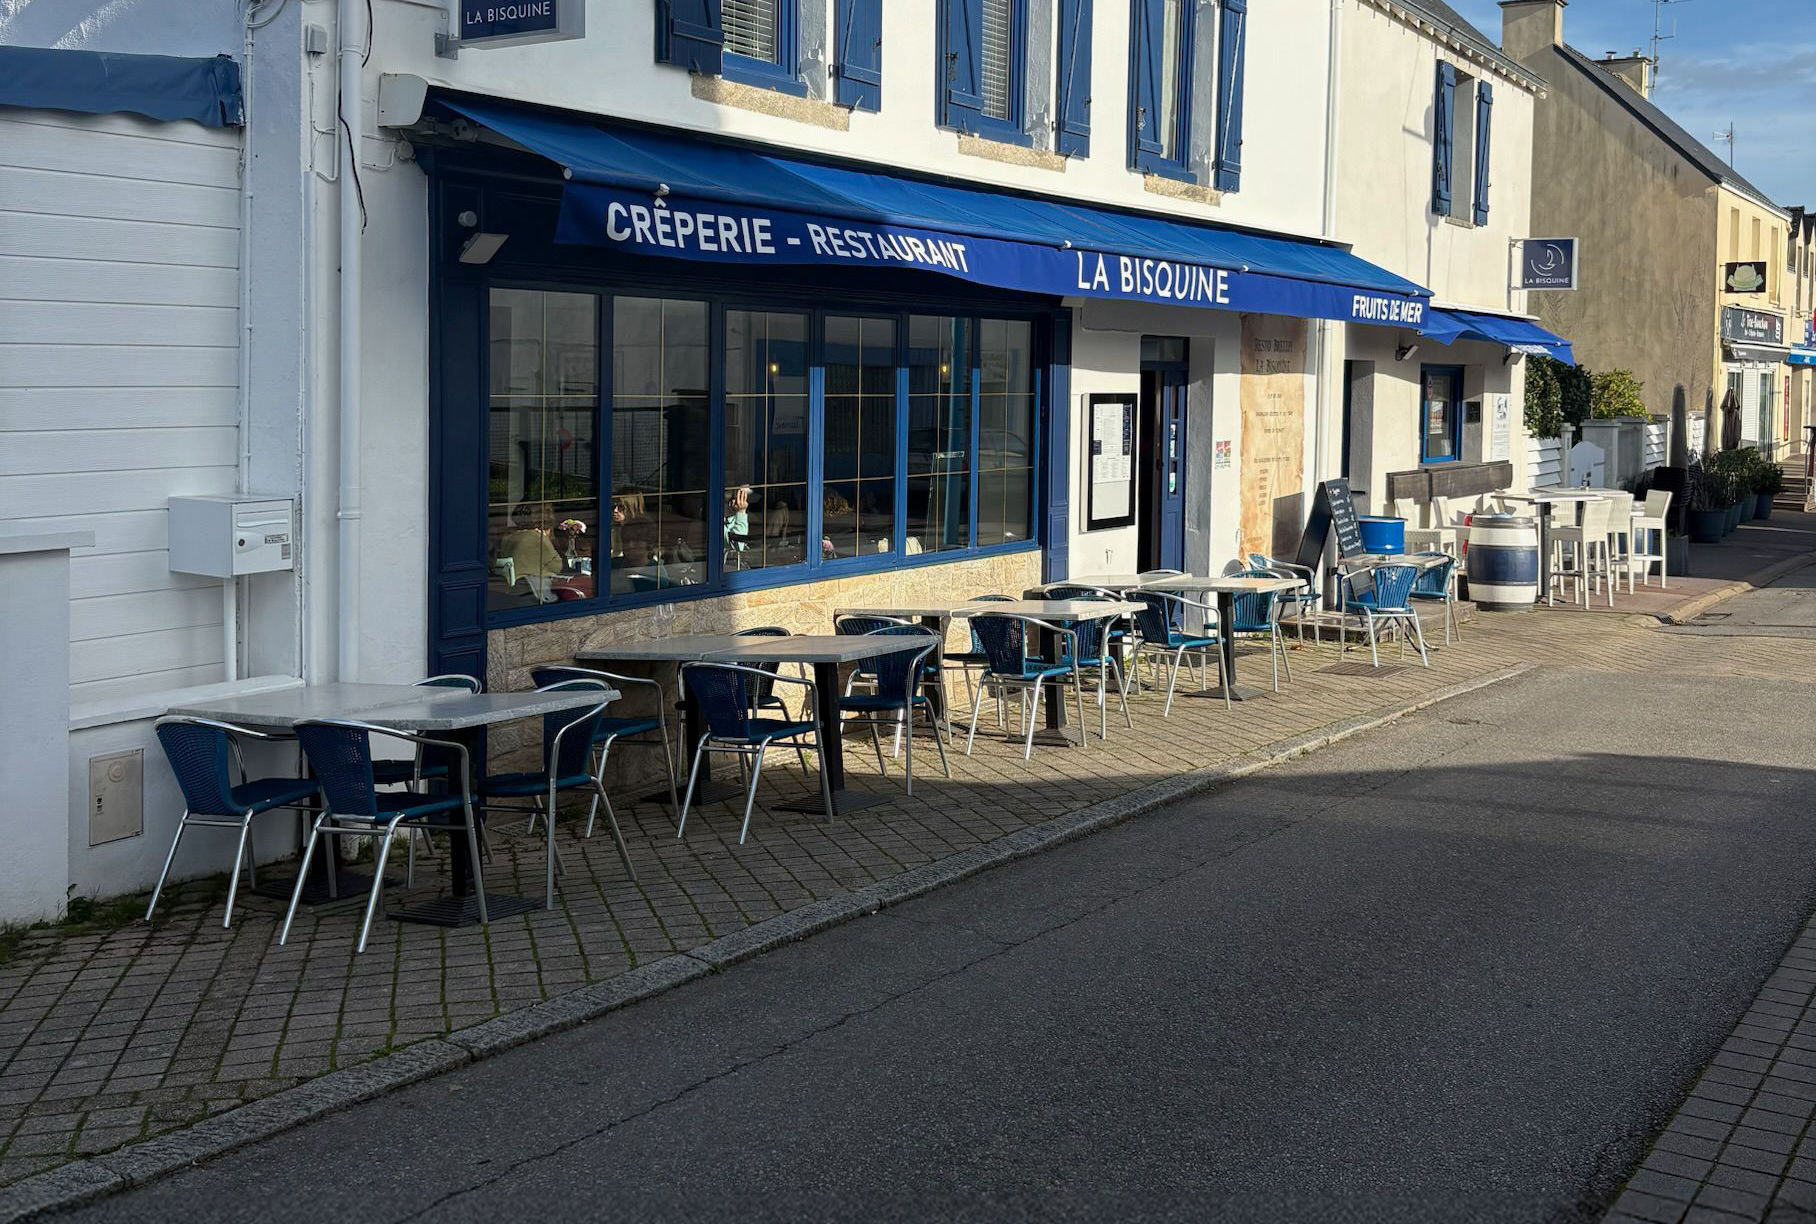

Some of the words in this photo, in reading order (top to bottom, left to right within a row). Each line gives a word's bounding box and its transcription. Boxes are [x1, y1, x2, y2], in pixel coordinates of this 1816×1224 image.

[466, 10, 483, 25] LA
[487, 1, 551, 23] BISQUINE
[606, 197, 776, 254] CRÊPERIE
[806, 222, 969, 273] RESTAURANT
[1077, 251, 1110, 291] LA
[1120, 256, 1230, 304] BISQUINE
[1351, 294, 1389, 321] FRUITS
[1389, 299, 1399, 321] DE
[1400, 301, 1423, 323] MER
